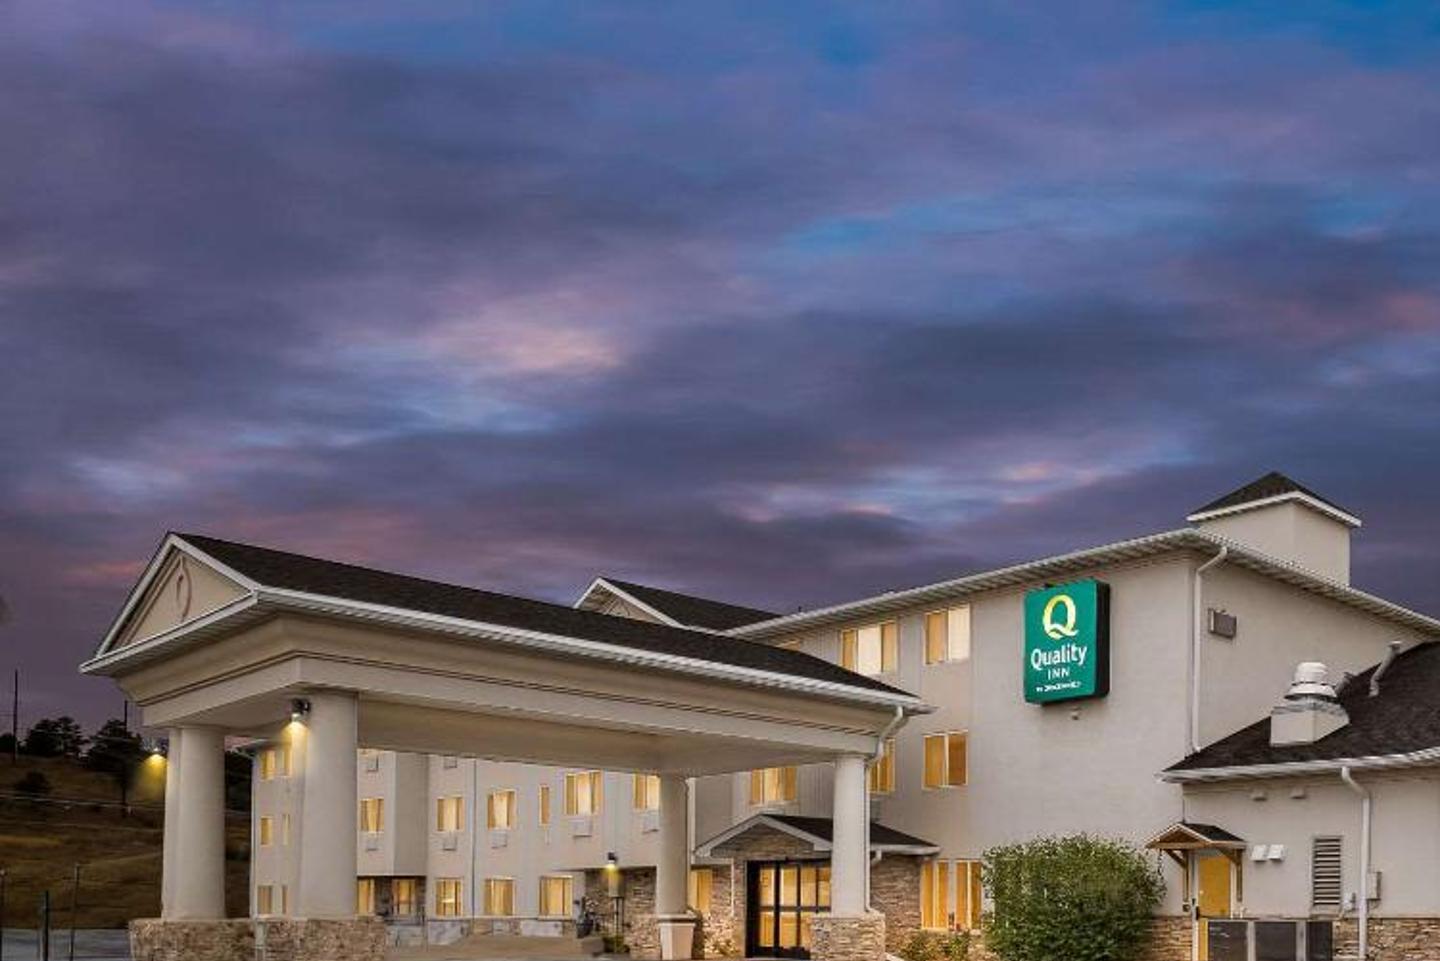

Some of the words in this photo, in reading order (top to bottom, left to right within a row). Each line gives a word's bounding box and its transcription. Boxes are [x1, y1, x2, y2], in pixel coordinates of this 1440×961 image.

[1042, 594, 1079, 639] Q
[1031, 642, 1088, 670] Quality
[1047, 667, 1070, 680] INN
